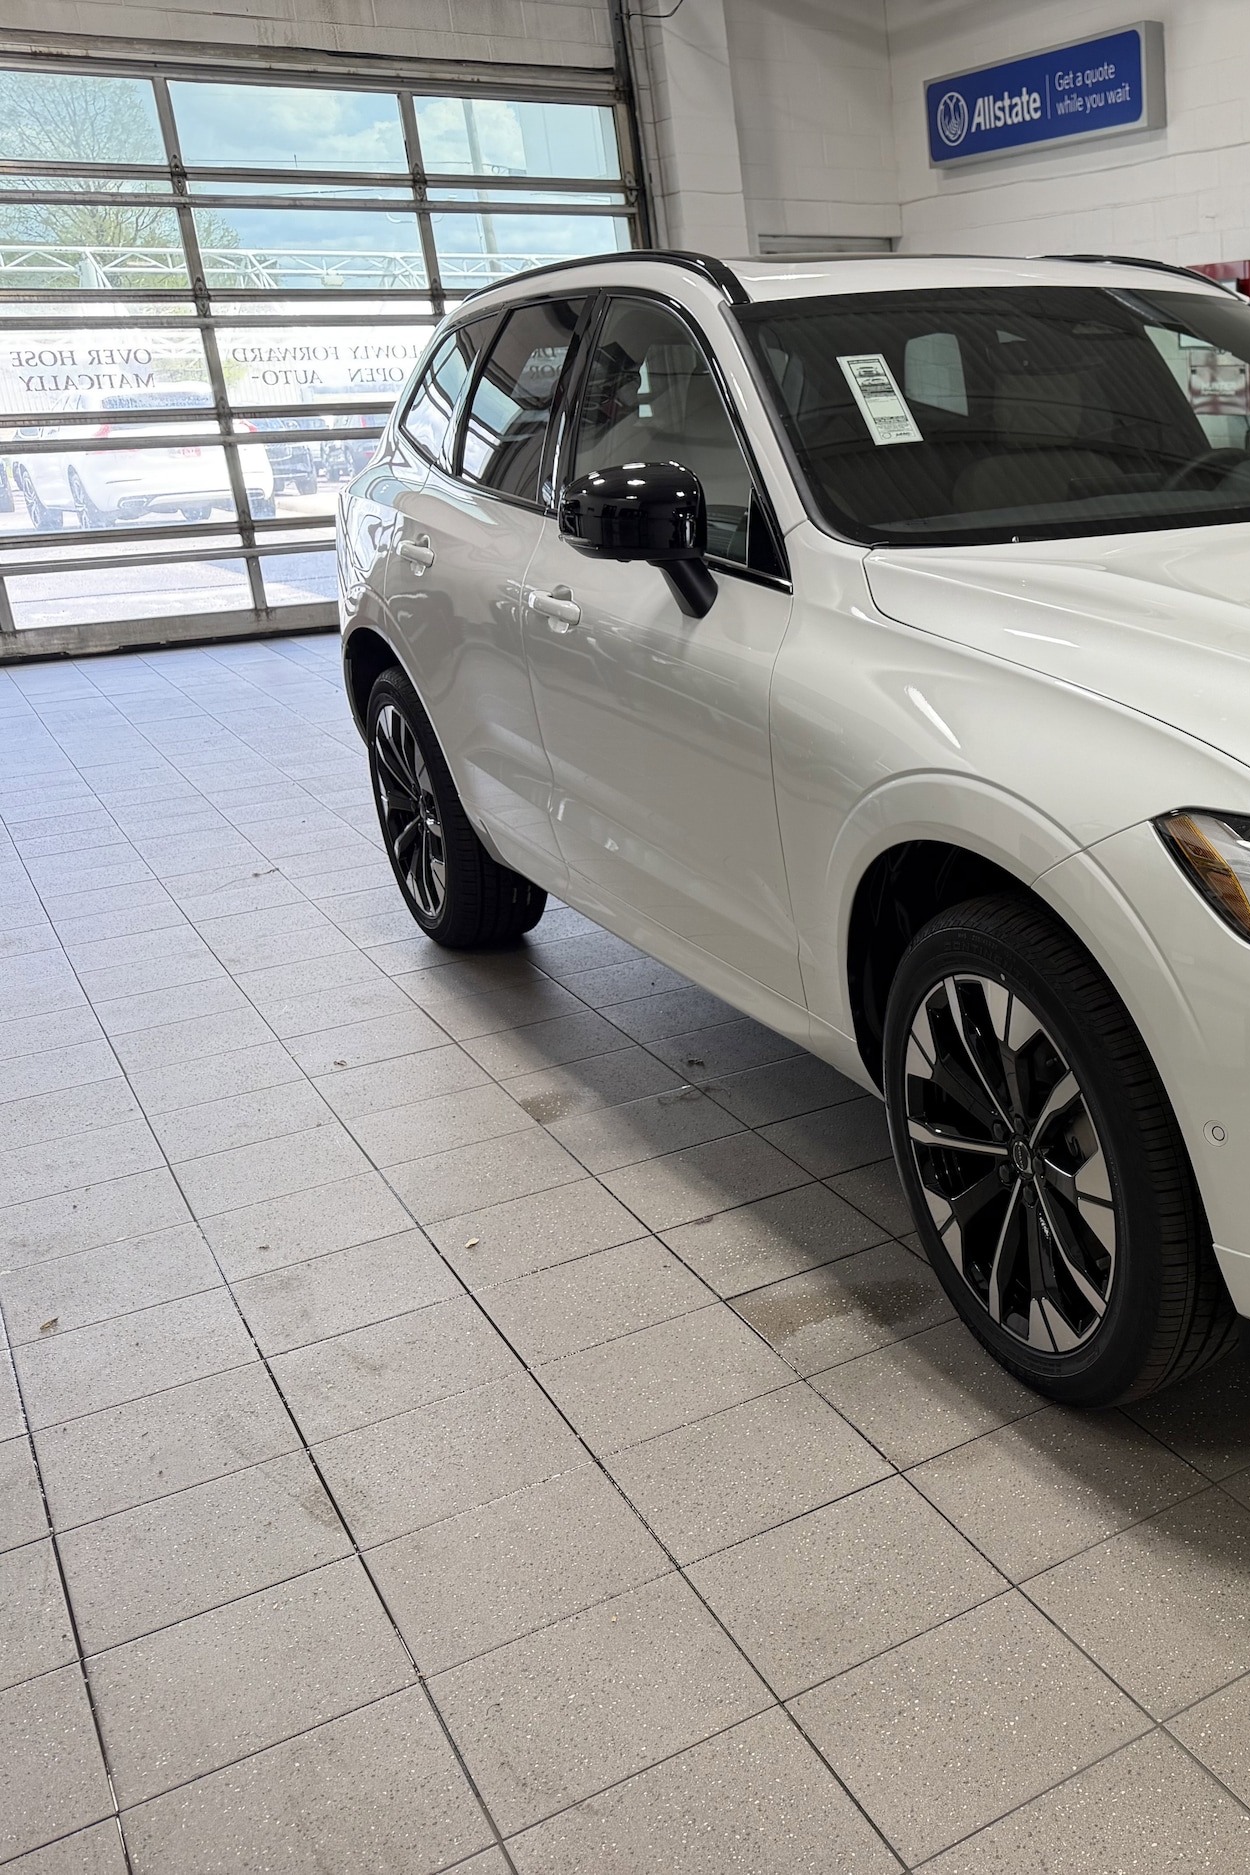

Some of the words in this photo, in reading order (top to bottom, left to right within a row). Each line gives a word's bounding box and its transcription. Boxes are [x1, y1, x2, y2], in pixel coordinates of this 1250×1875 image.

[1054, 70, 1074, 91] Get
[1075, 72, 1083, 86] a
[1084, 62, 1116, 88] quote
[971, 87, 1042, 133] Allstate
[1055, 94, 1084, 115] while
[1085, 92, 1105, 114] you
[1106, 83, 1131, 105] wait
